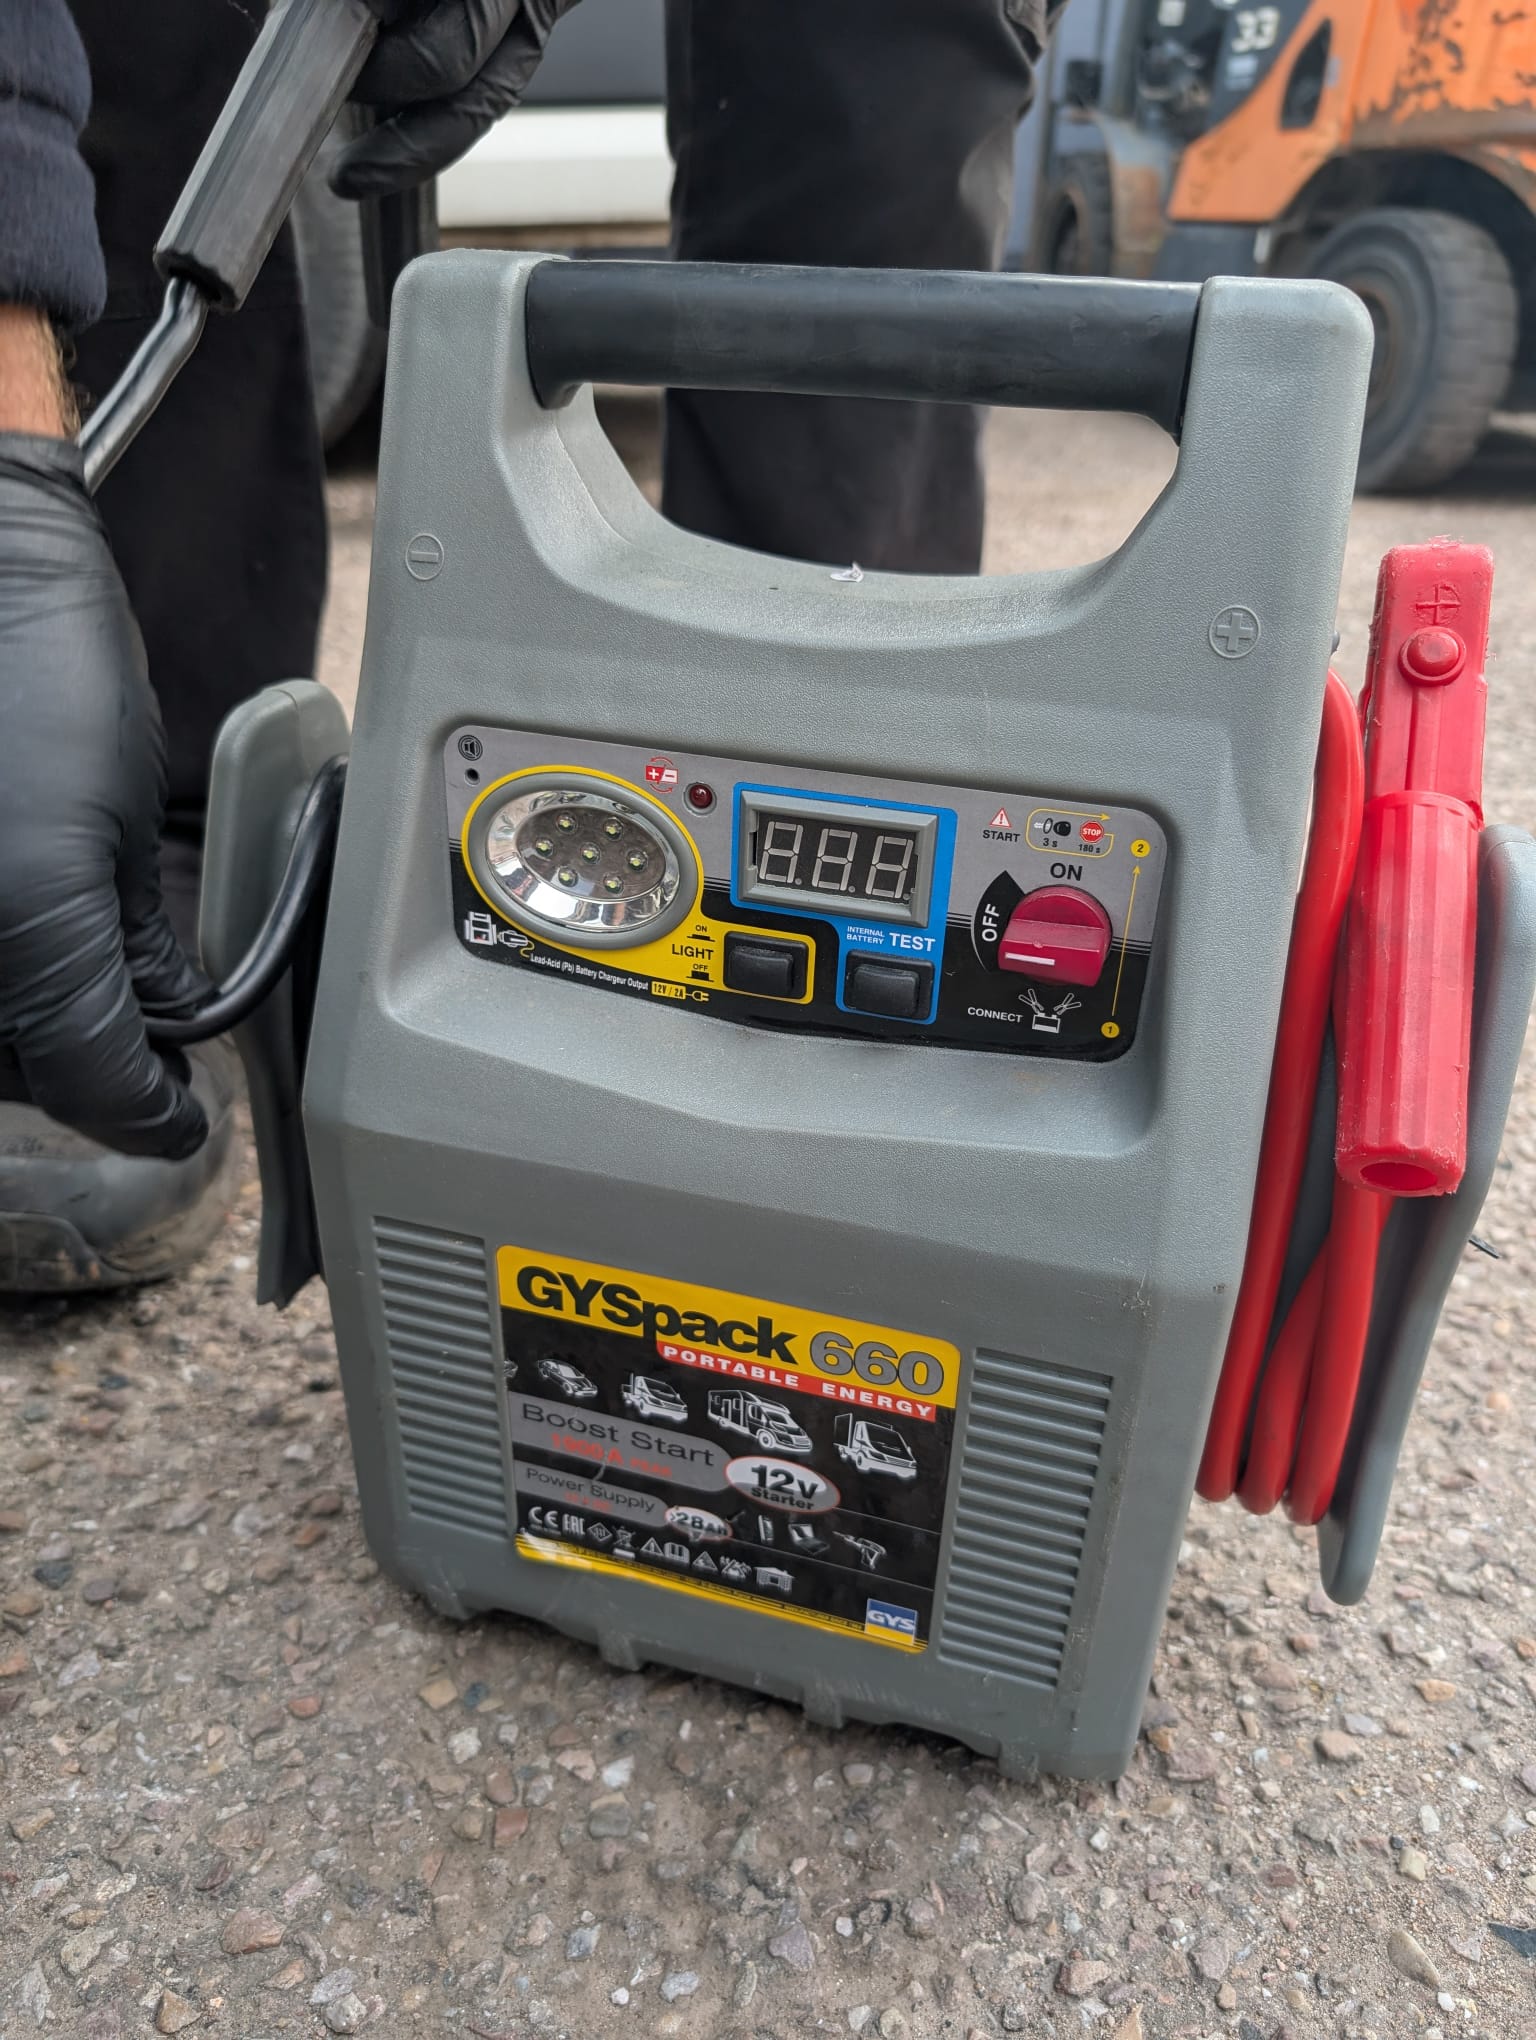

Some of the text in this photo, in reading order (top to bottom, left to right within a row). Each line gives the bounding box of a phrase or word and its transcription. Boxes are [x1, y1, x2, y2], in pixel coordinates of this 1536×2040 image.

[1232, 6, 1280, 52] 33
[982, 829, 1021, 843] START
[1082, 828, 1101, 836] STOP
[1043, 837, 1050, 847] 3
[1078, 843, 1093, 853] 180
[1050, 862, 1083, 881] ON
[695, 925, 707, 933] ON
[847, 925, 885, 937] INTERNAL
[981, 903, 1000, 942] OFF
[846, 934, 885, 945] BATTERY
[889, 932, 936, 952] TEST
[671, 943, 714, 960] LIGHT
[530, 953, 649, 990] Lead-Acid (Pb) Battery Chargeur Output
[693, 963, 708, 972] OFF
[653, 982, 667, 995] 12V
[674, 987, 684, 998] 2A
[967, 1006, 1023, 1023] CONNECT
[516, 1265, 945, 1396] GYSpack 660
[663, 1345, 932, 1418] PORTABLE ENERGY
[522, 1403, 714, 1466] Boost Start
[527, 1468, 584, 1492] Power
[590, 1484, 656, 1513] Supply
[751, 1487, 814, 1510] Starter
[867, 1609, 915, 1631] GYS
